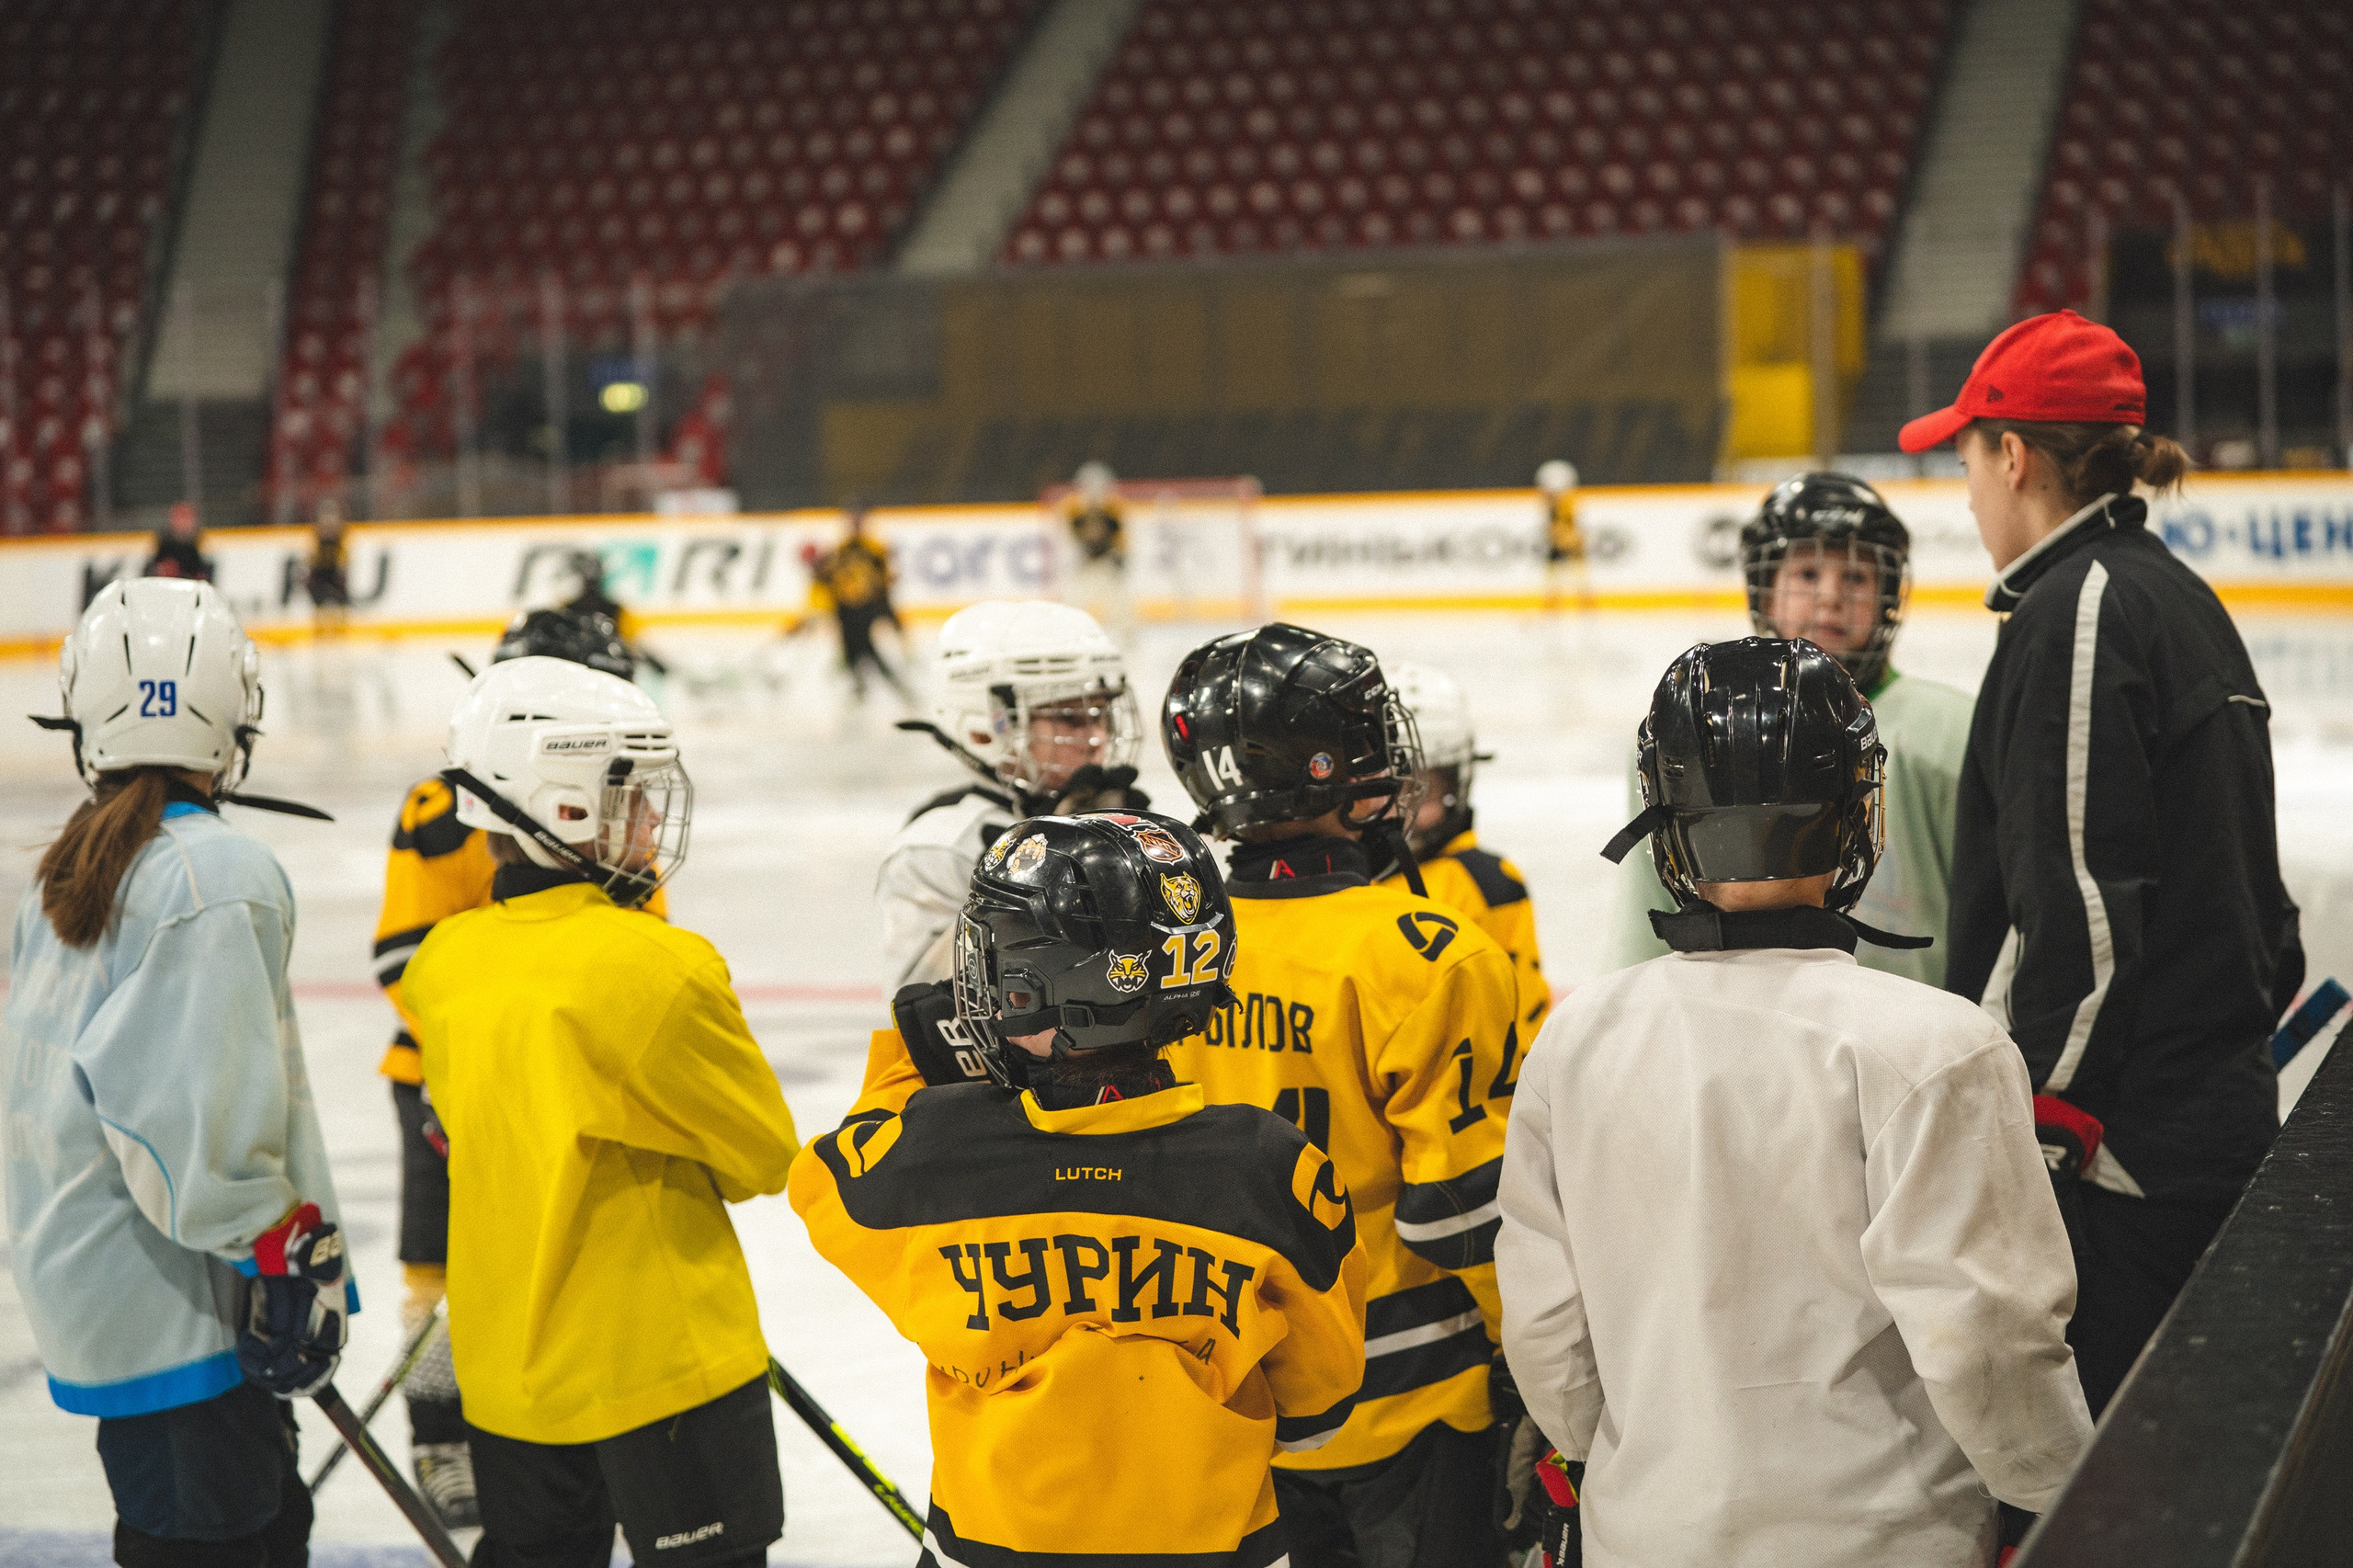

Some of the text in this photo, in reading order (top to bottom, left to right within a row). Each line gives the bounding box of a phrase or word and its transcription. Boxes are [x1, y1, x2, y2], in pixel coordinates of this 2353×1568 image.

[139, 680, 176, 717] 29
[1201, 744, 1244, 791] 14
[1160, 928, 1220, 990] 12
[1055, 1167, 1122, 1181] LUTCH
[938, 1233, 1256, 1341] ЧУРИН
